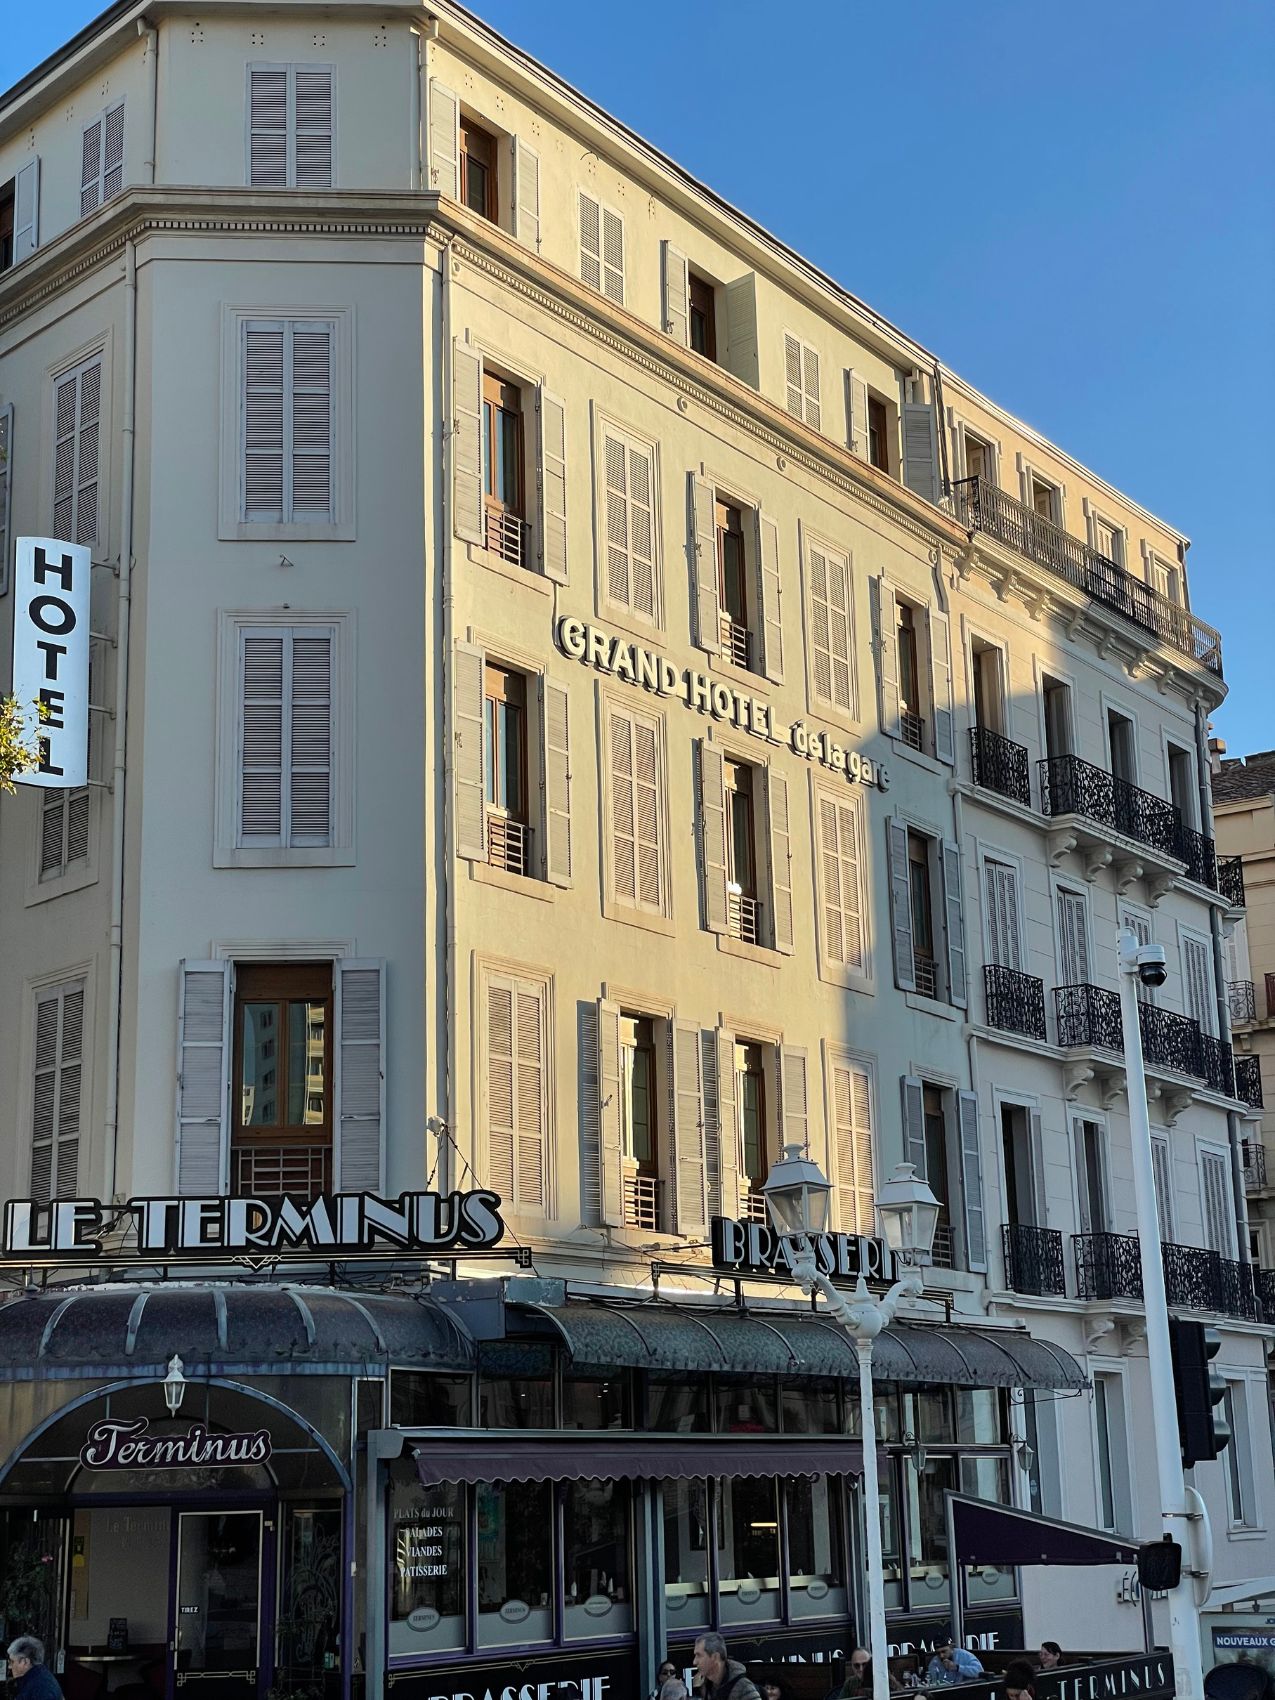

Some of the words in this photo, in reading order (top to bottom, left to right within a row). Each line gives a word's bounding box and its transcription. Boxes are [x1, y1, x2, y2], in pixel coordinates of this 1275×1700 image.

[28, 547, 76, 776] HOTEL
[557, 615, 681, 698] GRAND
[688, 668, 783, 746] HOTEL
[792, 719, 823, 760] de
[823, 731, 846, 771] la
[846, 750, 891, 792] gare
[7, 1202, 96, 1250] LE
[131, 1193, 502, 1249] TERMINUS
[722, 1219, 905, 1281] BRASERI
[86, 1423, 266, 1465] Terminus
[393, 1507, 420, 1519] PLATS
[432, 1507, 454, 1518] JOUR
[400, 1564, 448, 1577] PATISSERIE
[406, 1545, 443, 1557] VIANDES
[1216, 1636, 1268, 1646] NOUVEAUX
[1057, 1662, 1165, 1700] TERMINUS
